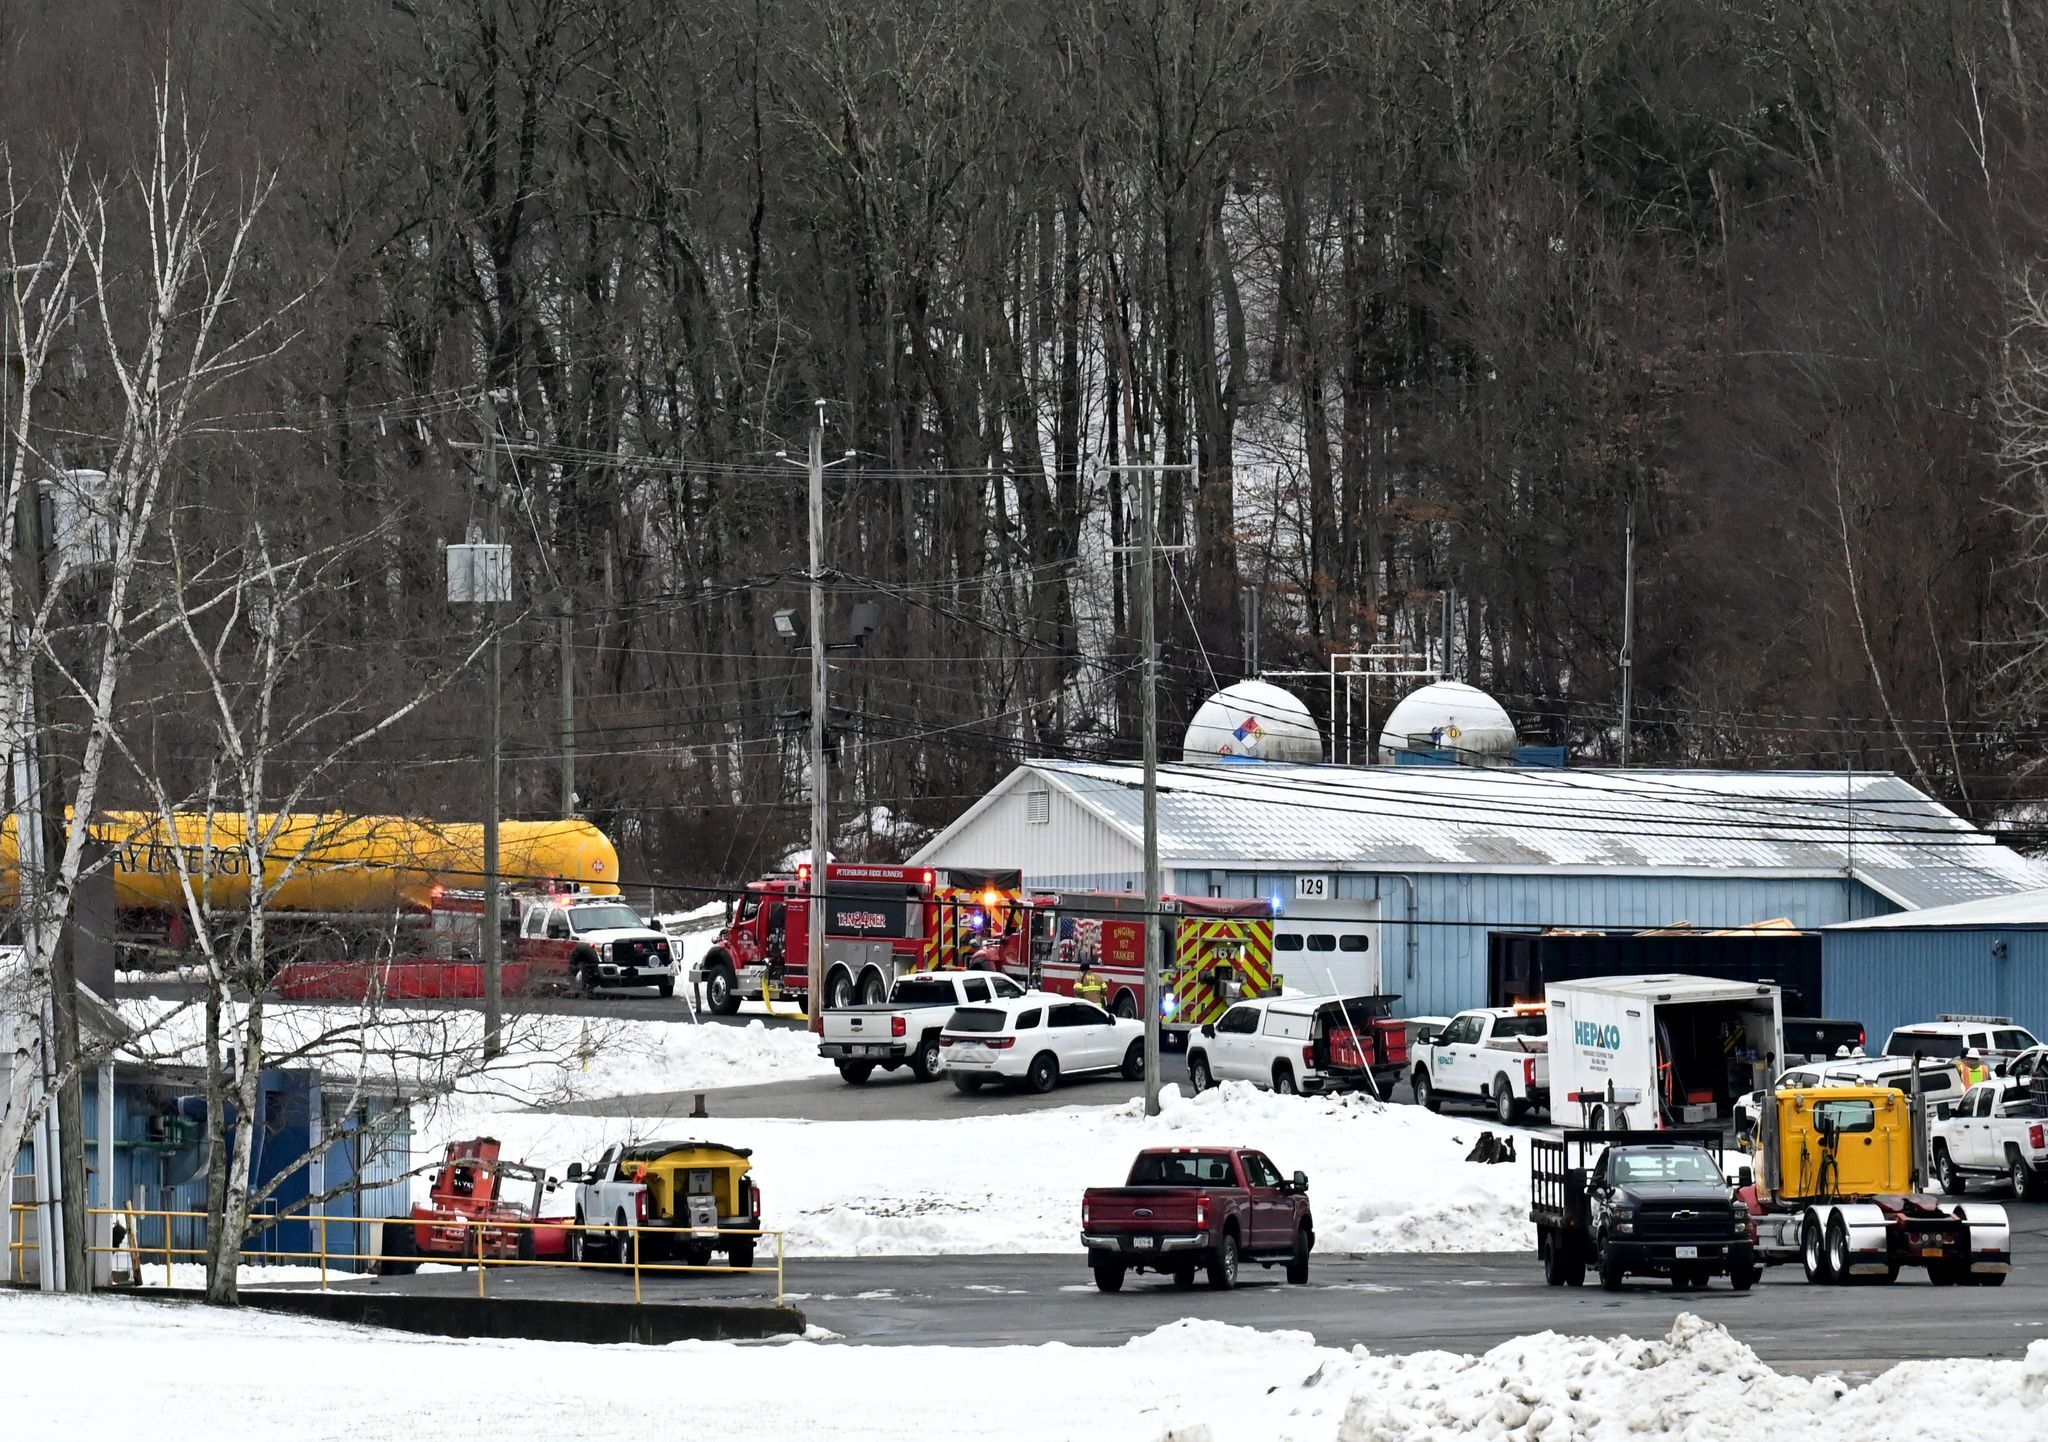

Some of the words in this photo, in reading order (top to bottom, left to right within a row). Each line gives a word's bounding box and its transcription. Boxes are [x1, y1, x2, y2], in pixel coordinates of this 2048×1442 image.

[1450, 727, 1457, 739] 0
[114, 844, 149, 874] AY
[836, 868, 868, 878] PETERSBURGH
[868, 869, 882, 878] RIDGE
[882, 869, 904, 879] RUNNERS
[1301, 878, 1323, 895] 129
[1113, 925, 1136, 940] ENGINE
[1119, 939, 1129, 949] 167
[1112, 950, 1135, 961] TANKER
[1211, 946, 1238, 960] 167
[1574, 1020, 1621, 1051] HEPACO
